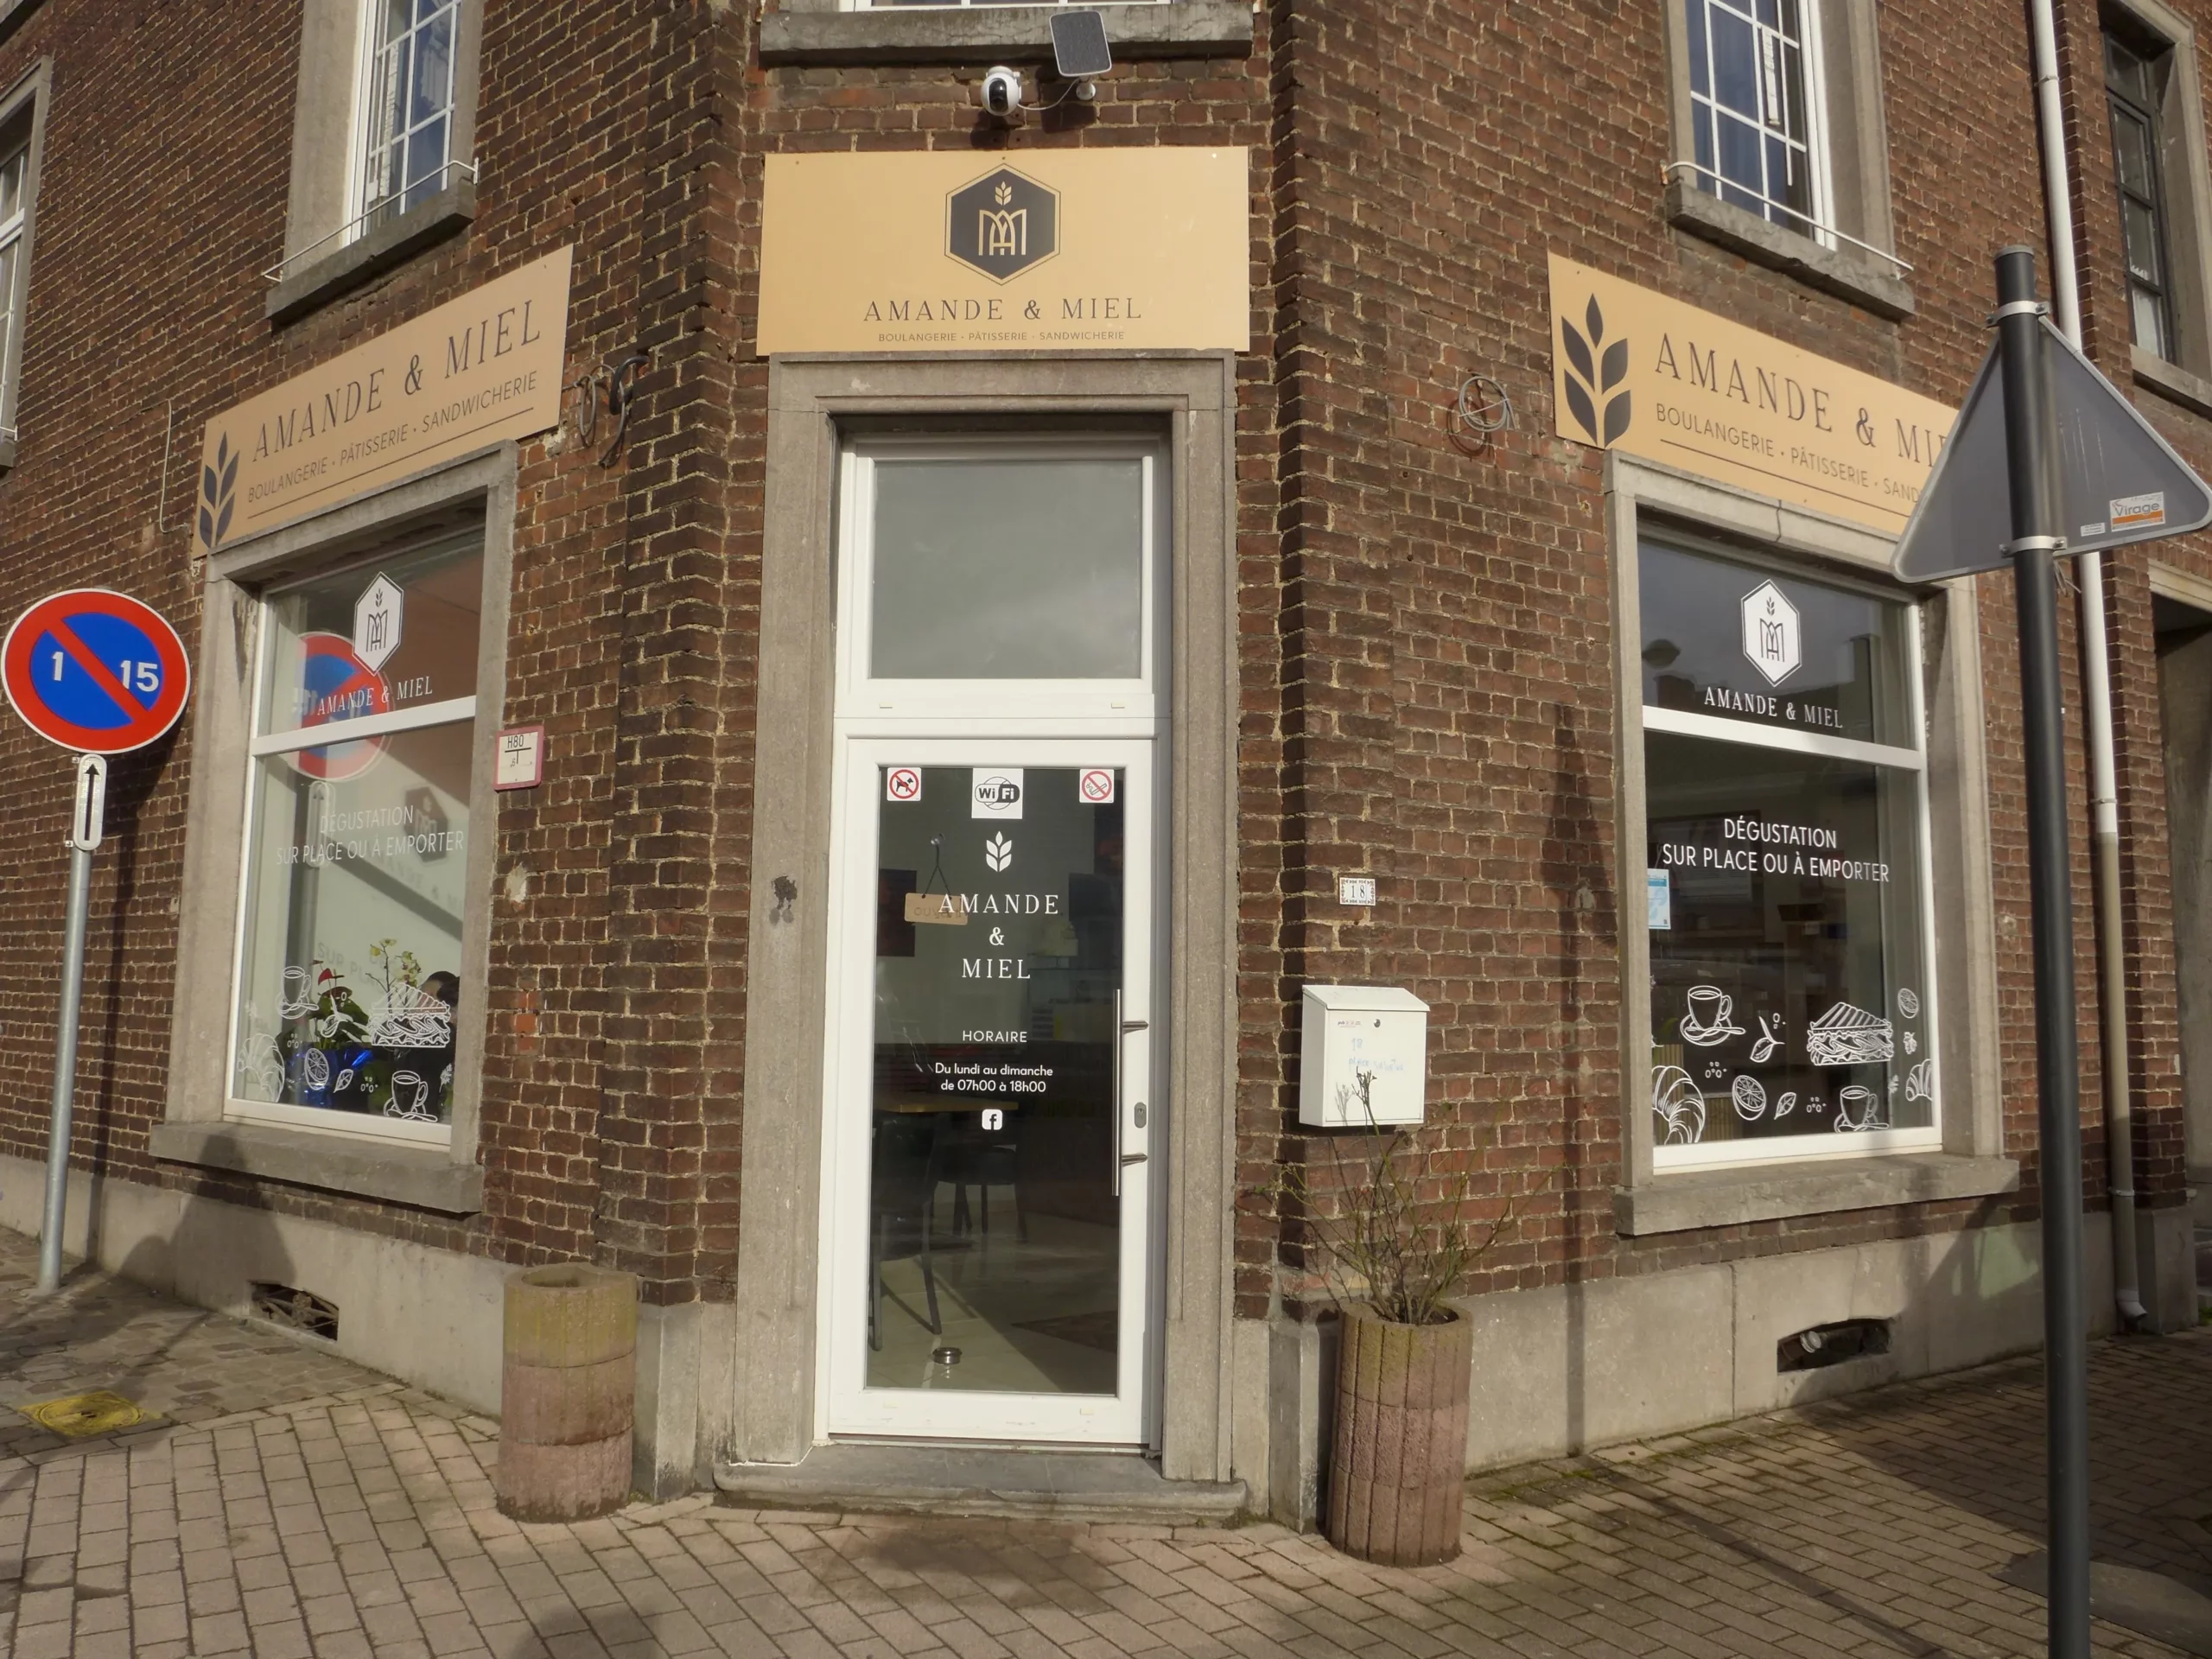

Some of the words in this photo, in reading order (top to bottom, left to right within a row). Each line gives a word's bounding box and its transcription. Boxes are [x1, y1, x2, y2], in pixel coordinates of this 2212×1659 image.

[864, 298, 1003, 321] AMANDE
[1024, 299, 1041, 320] &
[1061, 297, 1141, 320] MIEL
[878, 332, 957, 342] BOULANGERIE
[969, 330, 1027, 341] PÂTISSERIE
[1039, 331, 1124, 341] SANDWICHERIE
[252, 368, 385, 462] AMANDE
[404, 354, 423, 396] &
[444, 300, 540, 379] MIEL
[1655, 333, 1833, 432] AMANDE
[1856, 407, 1876, 448] &
[248, 456, 328, 503] BOULANGERIE
[340, 423, 408, 467] PÂTISSERIE
[422, 371, 537, 433] SANDWICHERIE
[1656, 403, 1775, 457] BOULANGERIE
[1790, 446, 1869, 487] PÂTISSERIE
[2114, 502, 2160, 517] Virage
[52, 651, 63, 682] 1
[120, 660, 159, 692] 15
[317, 688, 374, 715] AMANDE
[381, 686, 390, 703] &
[397, 676, 433, 701] MIEL
[1704, 687, 1777, 716] AMANDE
[1786, 702, 1796, 721] &
[1804, 704, 1843, 728] MIEL
[507, 734, 524, 748] H80
[321, 804, 413, 834] DÉGUSTATION
[1724, 815, 1837, 849] DÉGUSTATION
[276, 846, 299, 865] SUR
[302, 842, 343, 862] PLACE
[347, 841, 367, 860] OU
[372, 833, 381, 856] À
[386, 830, 464, 856] EMPORTER
[1662, 843, 1696, 866] SUR
[1703, 847, 1758, 872] PLACE
[1763, 853, 1788, 874] OU
[1793, 851, 1804, 875] À
[1810, 857, 1890, 882] EMPORTER
[938, 893, 1058, 914] AMANDE
[1351, 885, 1365, 899] 18
[989, 926, 1004, 945] &
[962, 958, 1031, 979] MIEL
[963, 1030, 1027, 1043] HORAIRE
[935, 1062, 951, 1074] Du
[954, 1063, 980, 1074] lundi
[1000, 1064, 1053, 1077] dimanche
[941, 1079, 954, 1090] de
[957, 1079, 996, 1091] 07h00
[999, 1082, 1007, 1091] à
[1009, 1080, 1046, 1092] 18h00
